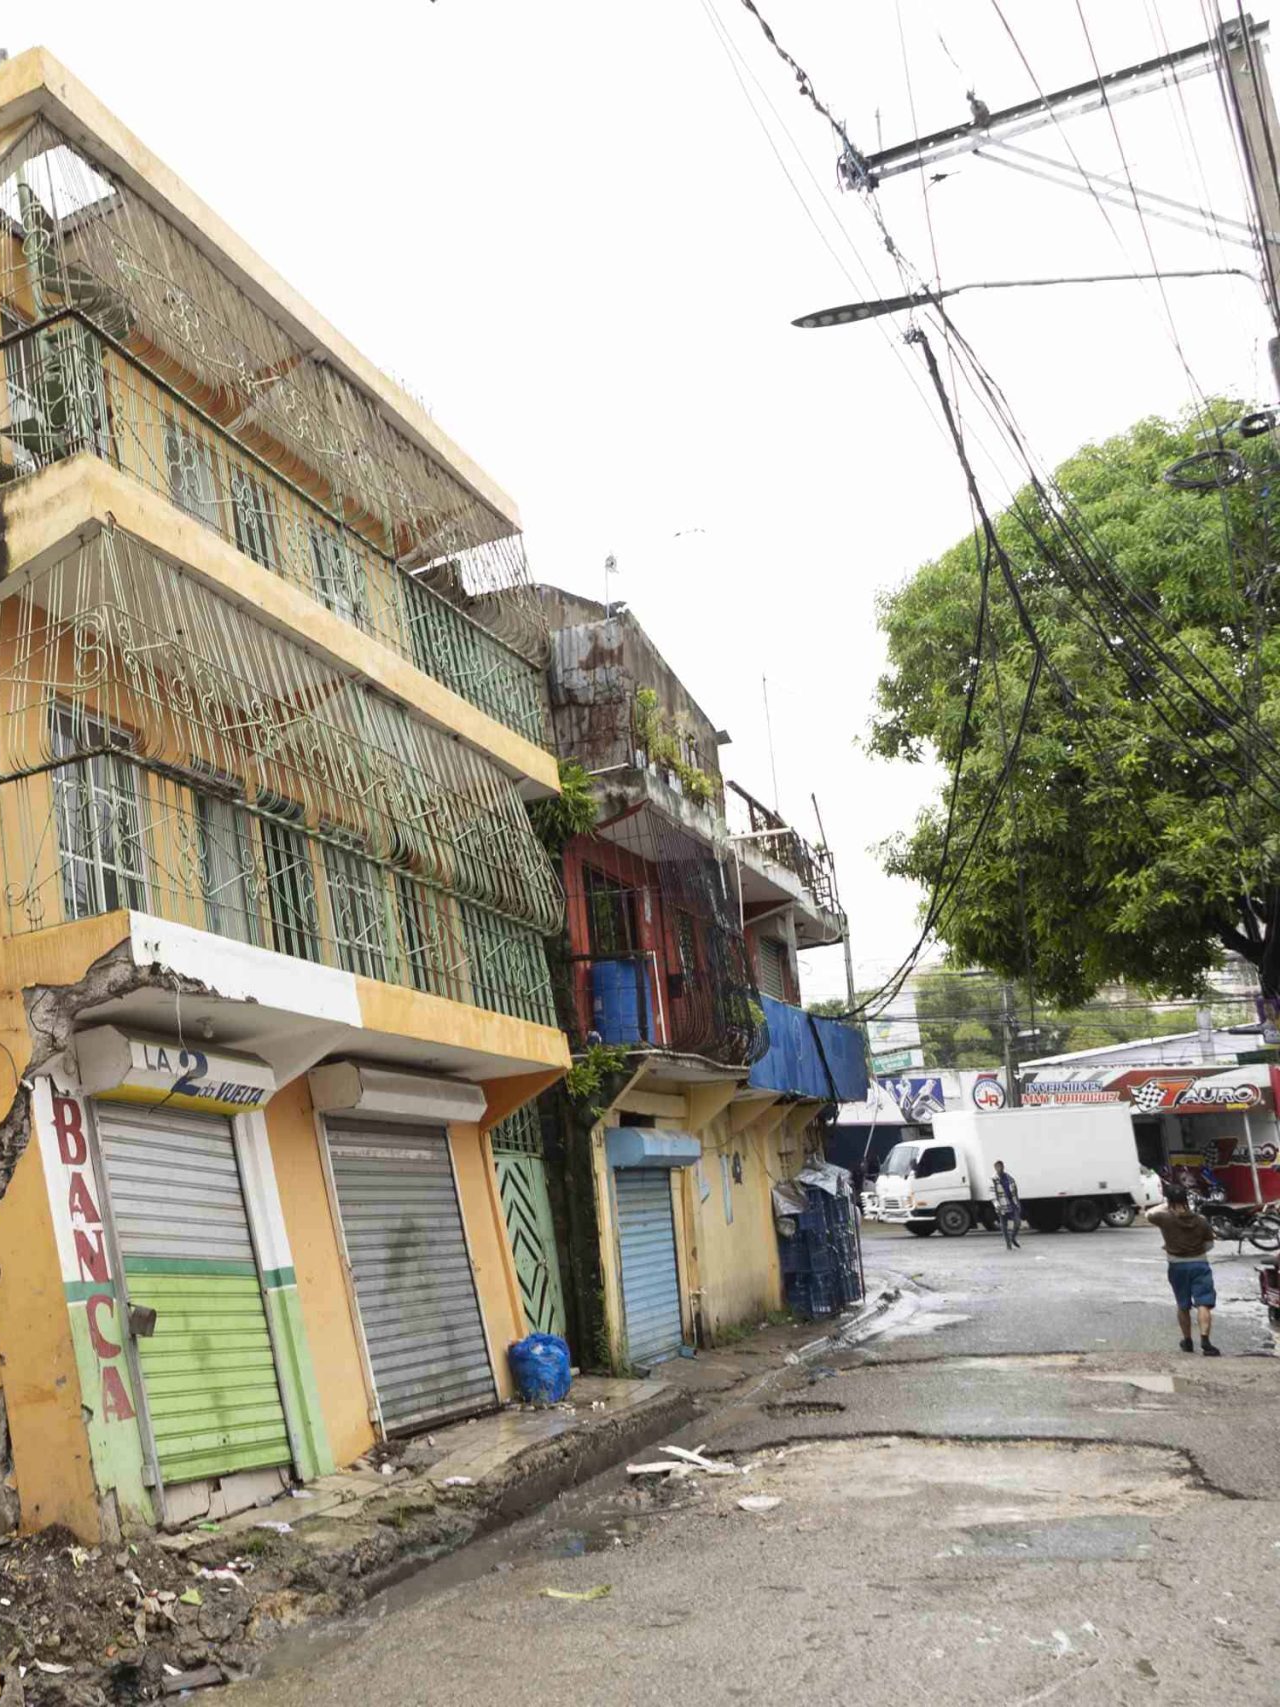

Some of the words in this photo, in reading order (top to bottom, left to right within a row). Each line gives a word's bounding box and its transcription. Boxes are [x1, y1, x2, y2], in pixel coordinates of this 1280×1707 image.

[144, 1044, 172, 1073] LA
[215, 1081, 265, 1106] VUELTA
[1157, 1078, 1258, 1108] TAURO
[51, 1097, 136, 1424] BANCA
